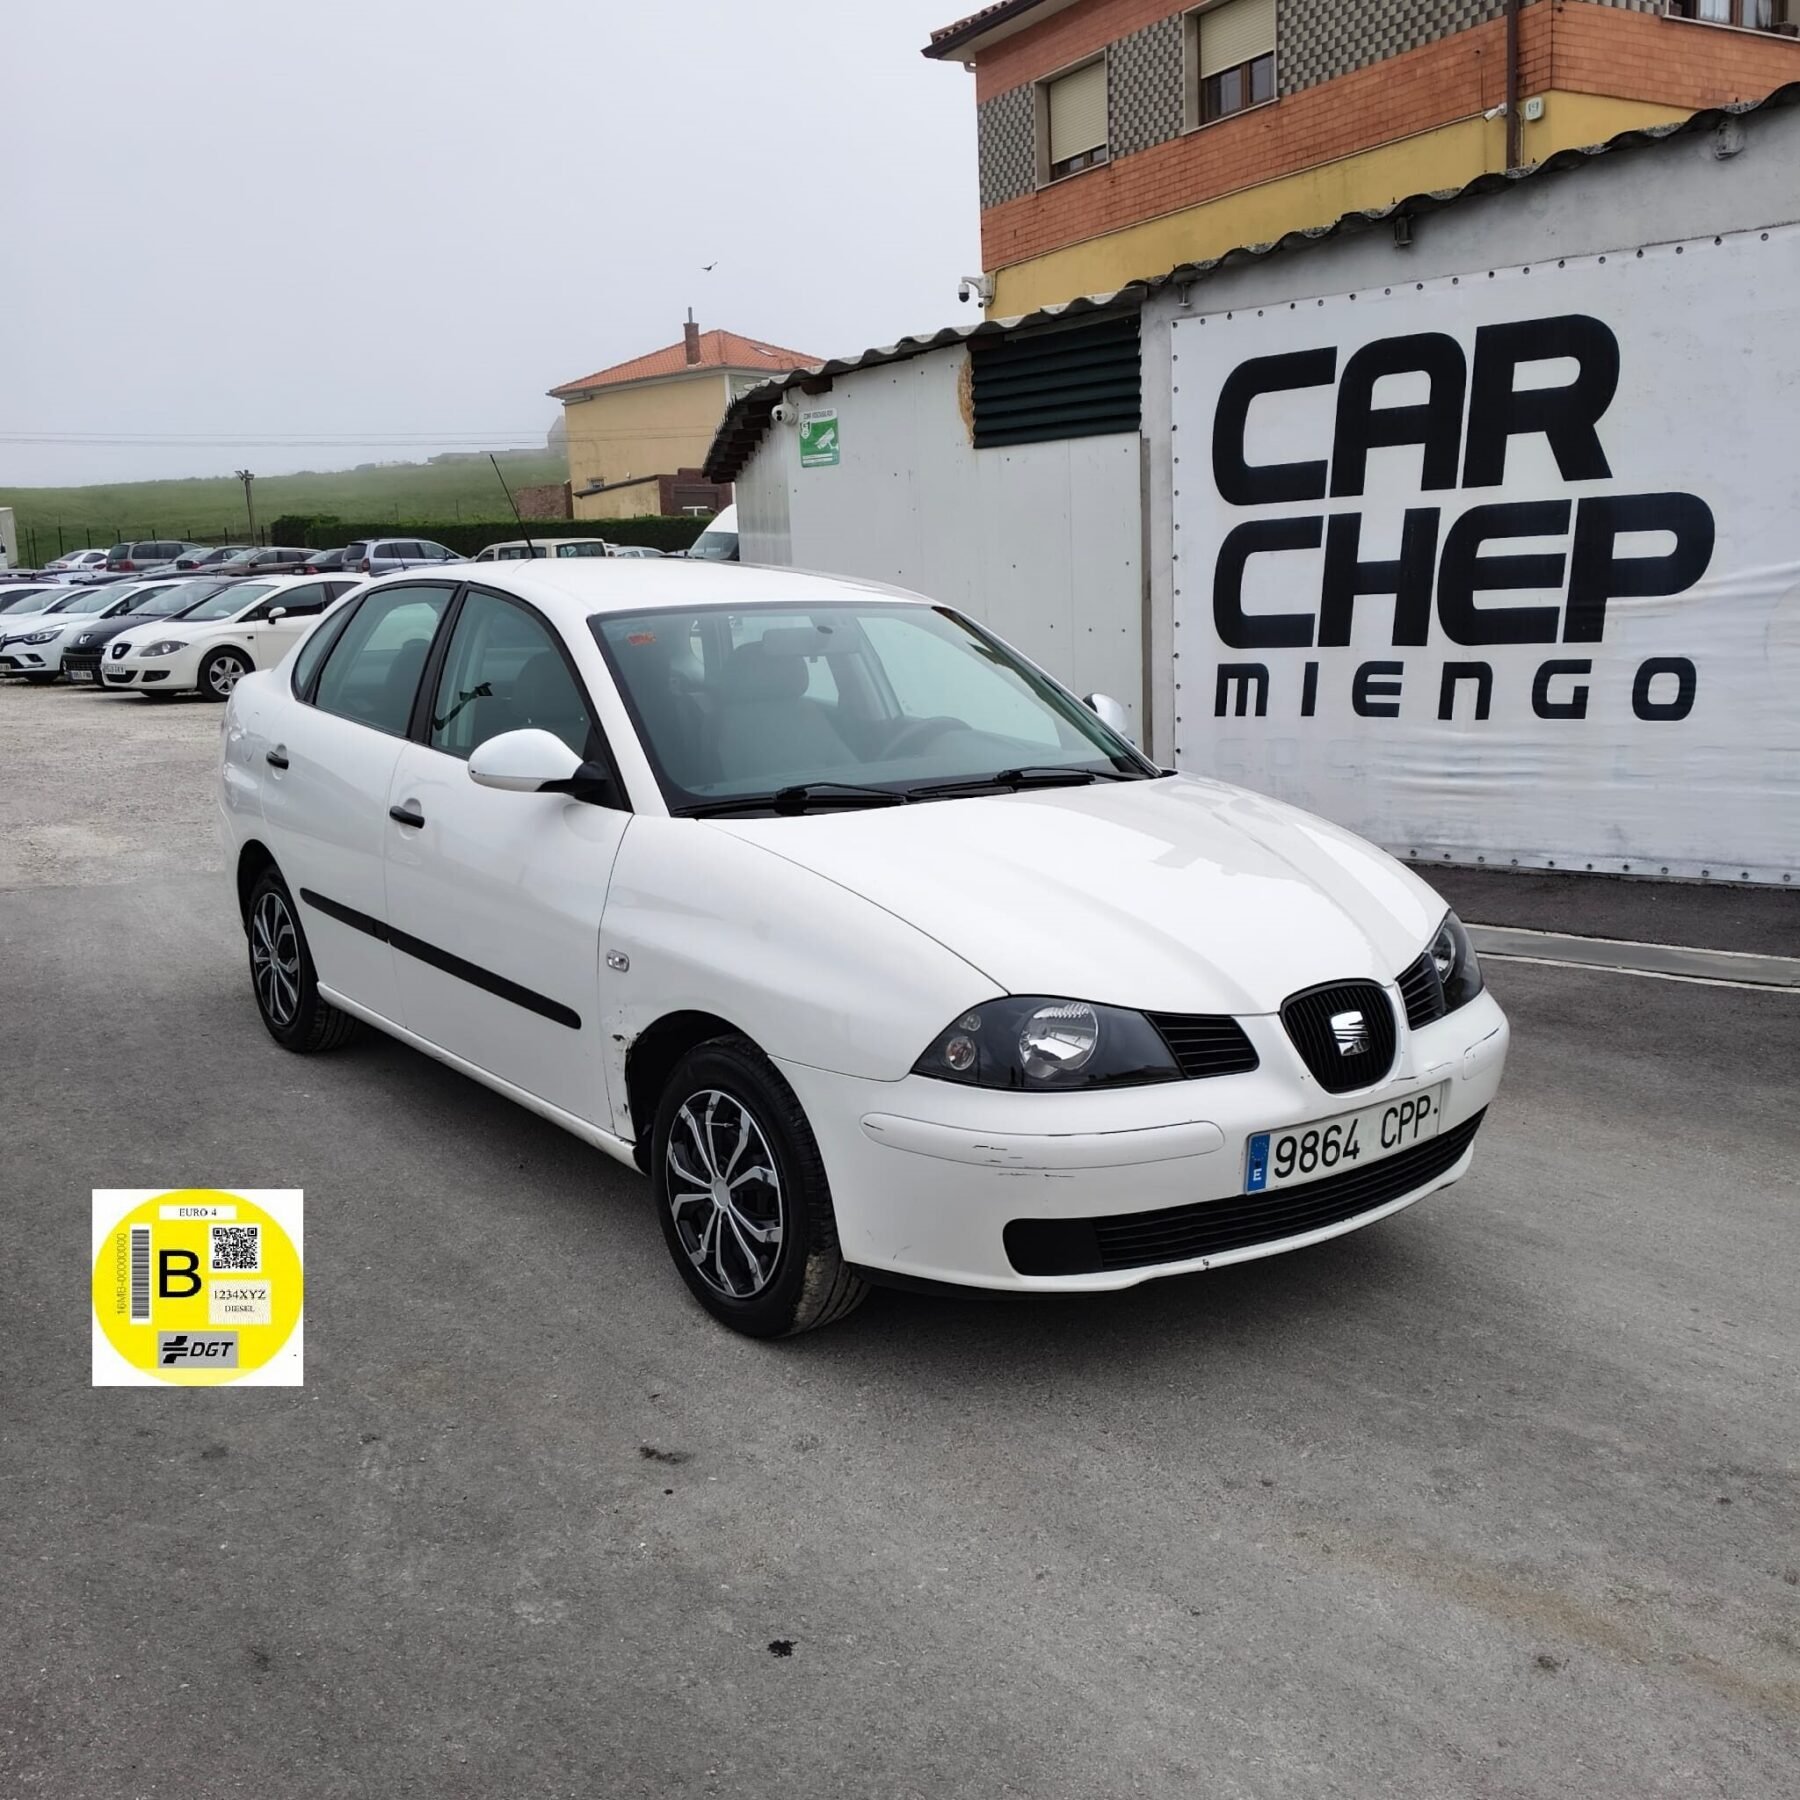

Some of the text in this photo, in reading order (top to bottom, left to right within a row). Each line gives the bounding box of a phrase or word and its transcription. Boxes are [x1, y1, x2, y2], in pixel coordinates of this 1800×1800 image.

[1212, 314, 1620, 506] CAR
[1213, 492, 1716, 649] CHEP
[1214, 657, 1697, 721] MIENGO
[1253, 1095, 1431, 1181] E 9864 CPP
